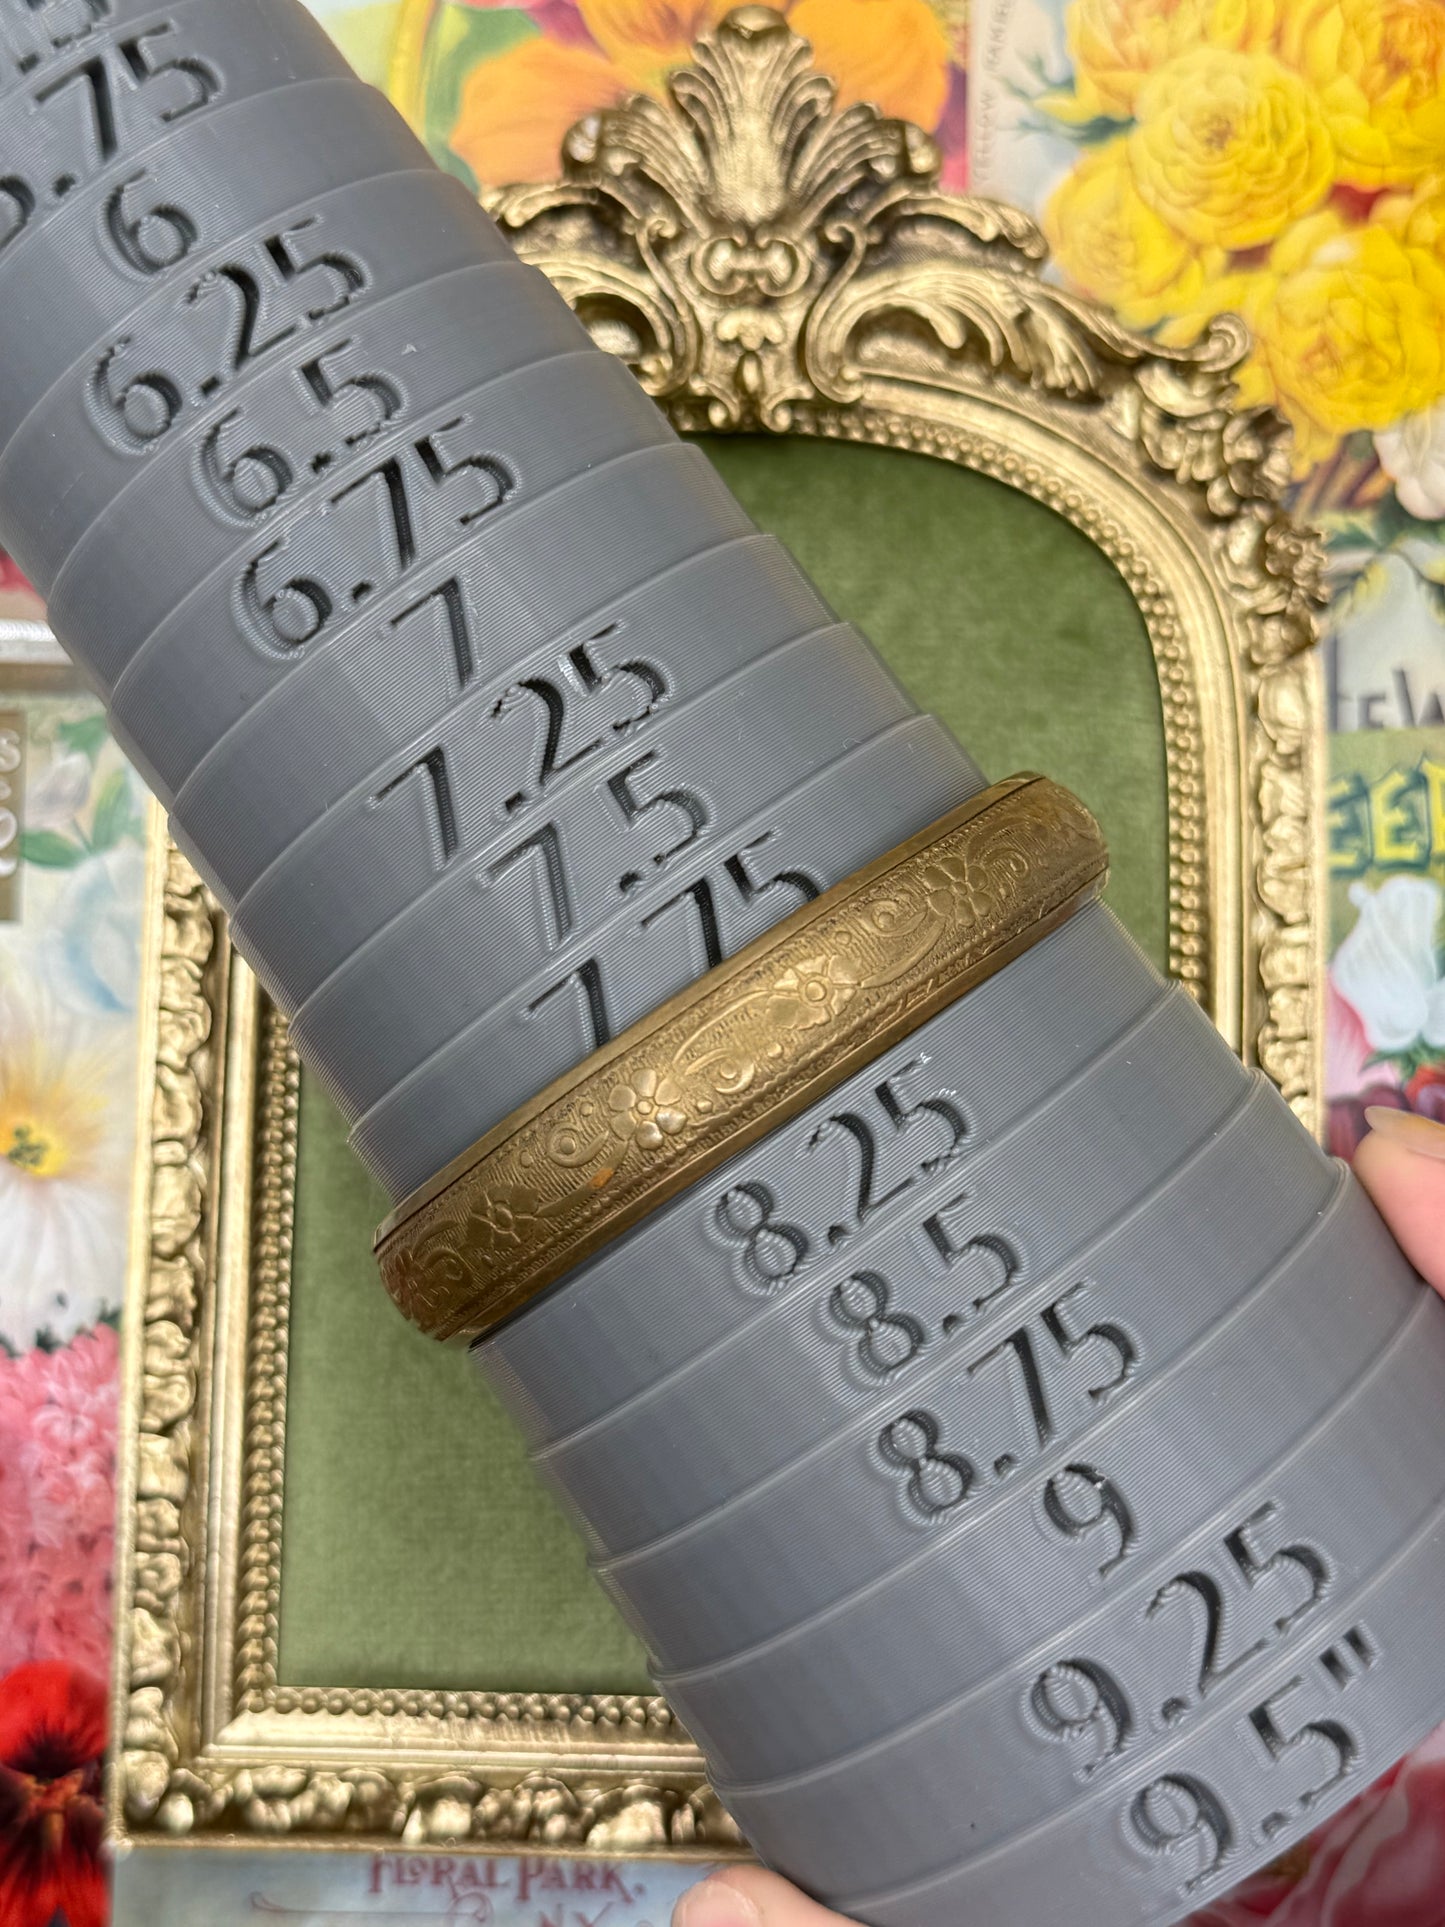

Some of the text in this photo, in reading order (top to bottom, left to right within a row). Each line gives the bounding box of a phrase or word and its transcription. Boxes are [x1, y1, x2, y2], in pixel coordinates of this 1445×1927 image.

[84, 214, 373, 455] 6.25
[99, 168, 198, 281] 6
[192, 336, 408, 528] 6.5
[232, 414, 523, 660] 6.75
[368, 620, 675, 871] 7.25
[379, 575, 480, 695] 7
[476, 747, 716, 951] 7.5
[520, 827, 829, 1053] 775
[703, 1052, 977, 1296] 8.25
[818, 1191, 1025, 1388] 8.5
[868, 1277, 1144, 1524] 8.75
[1033, 1462, 1139, 1579] 9
[1021, 1497, 1335, 1782] 9.25
[1120, 1620, 1384, 1893] 9.5"
